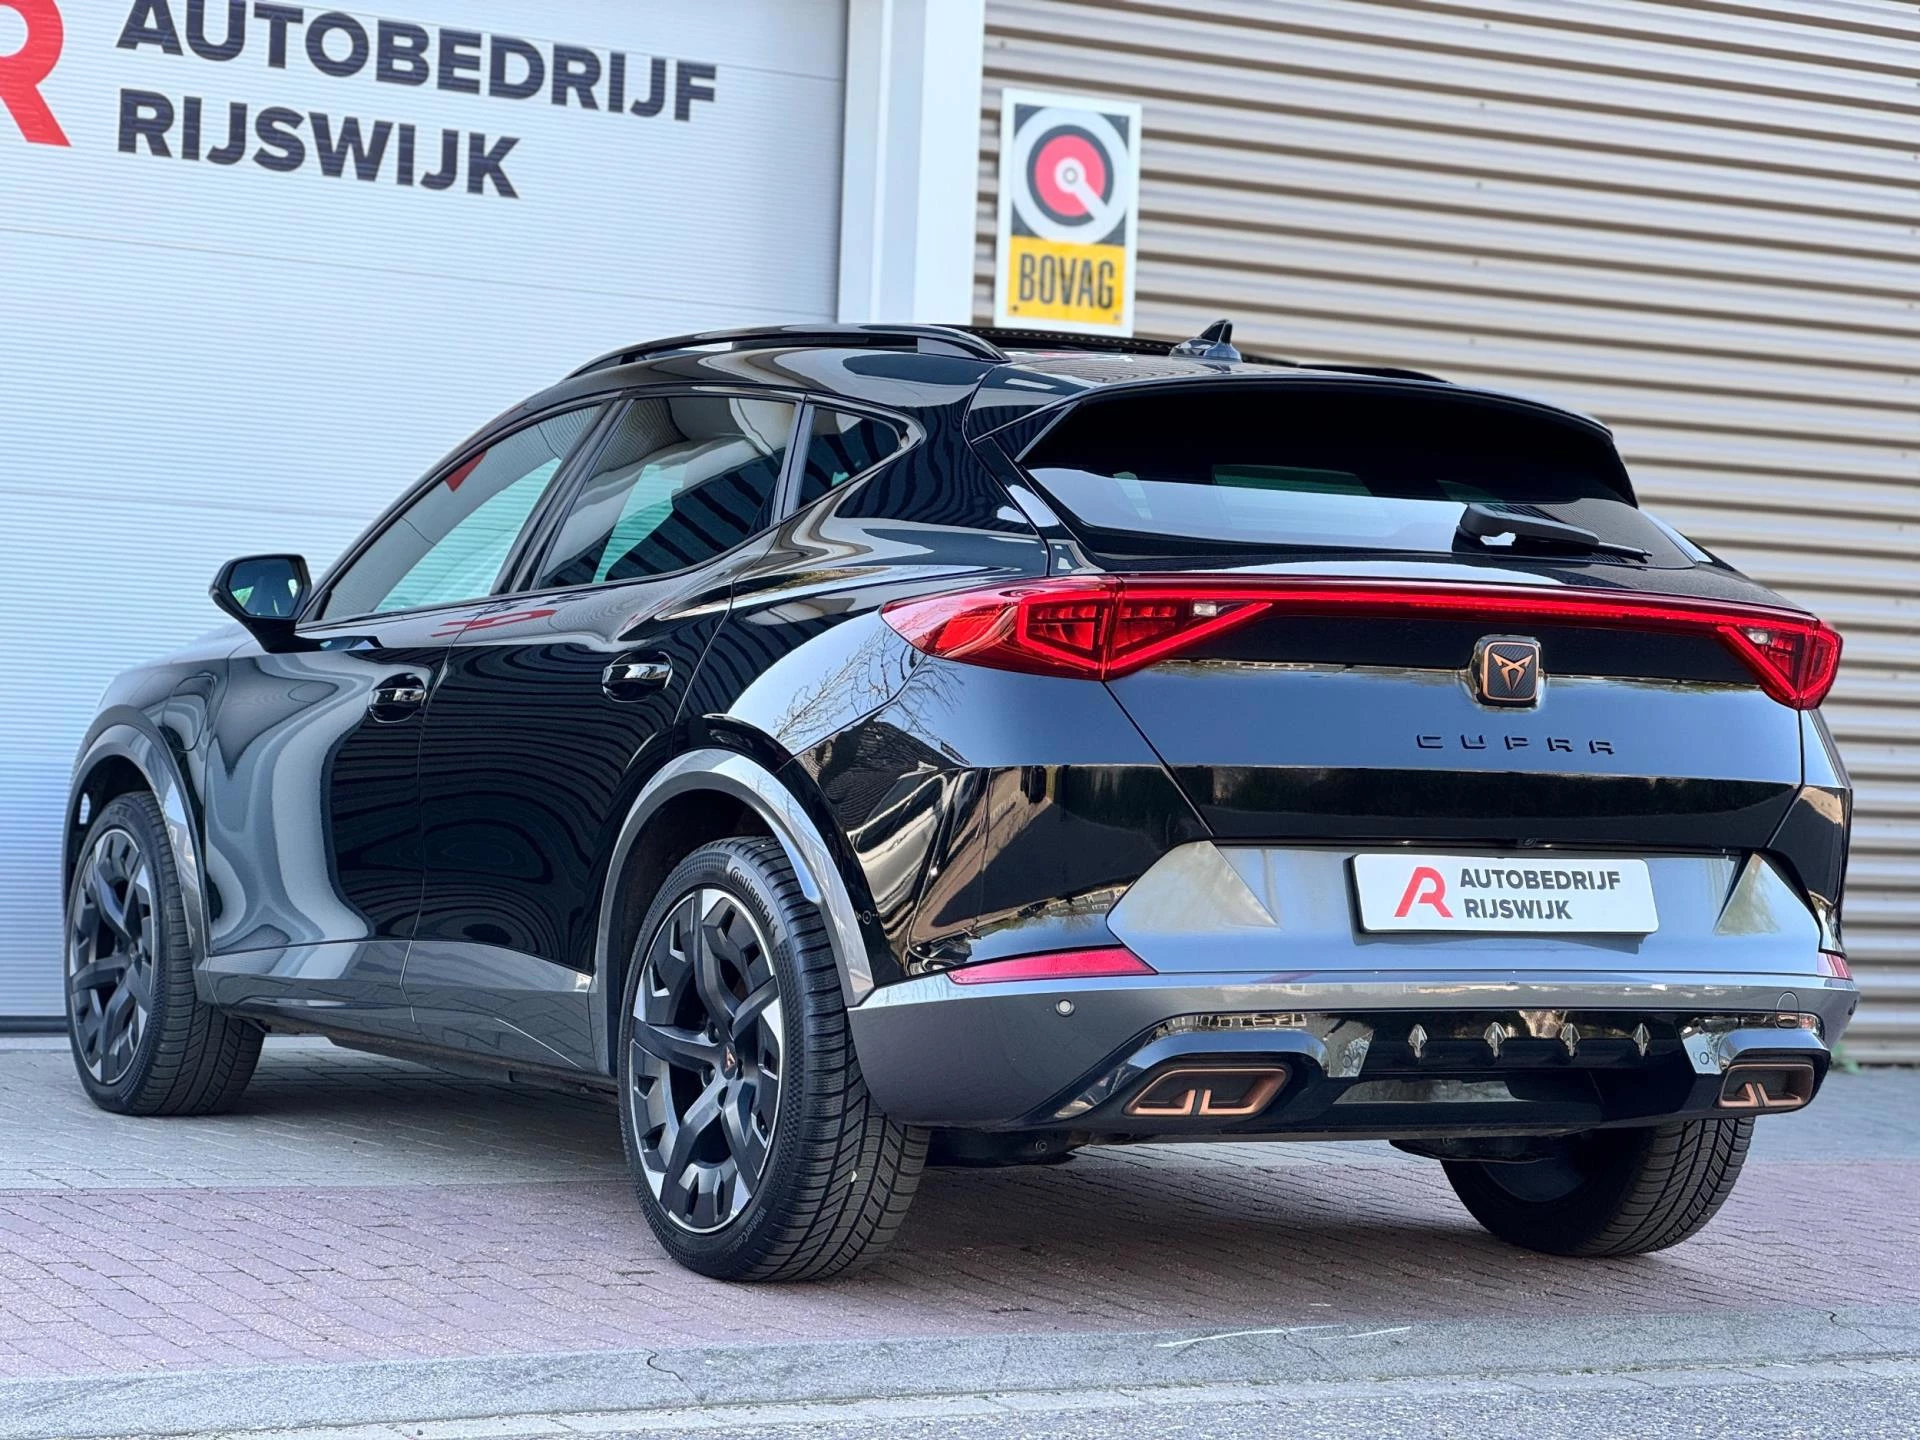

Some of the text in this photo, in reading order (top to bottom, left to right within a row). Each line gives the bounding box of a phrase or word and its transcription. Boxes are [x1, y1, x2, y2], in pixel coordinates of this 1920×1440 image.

[116, 0, 717, 122] AUTOBEDRIJF
[117, 88, 521, 199] RIJSWIJK
[1018, 253, 1114, 310] BOVAG
[1416, 734, 1615, 755] CUPRA
[730, 866, 774, 927] Continental
[1460, 868, 1621, 890] AUTOBEDRIJF
[1463, 898, 1573, 920] RIJSWIJK
